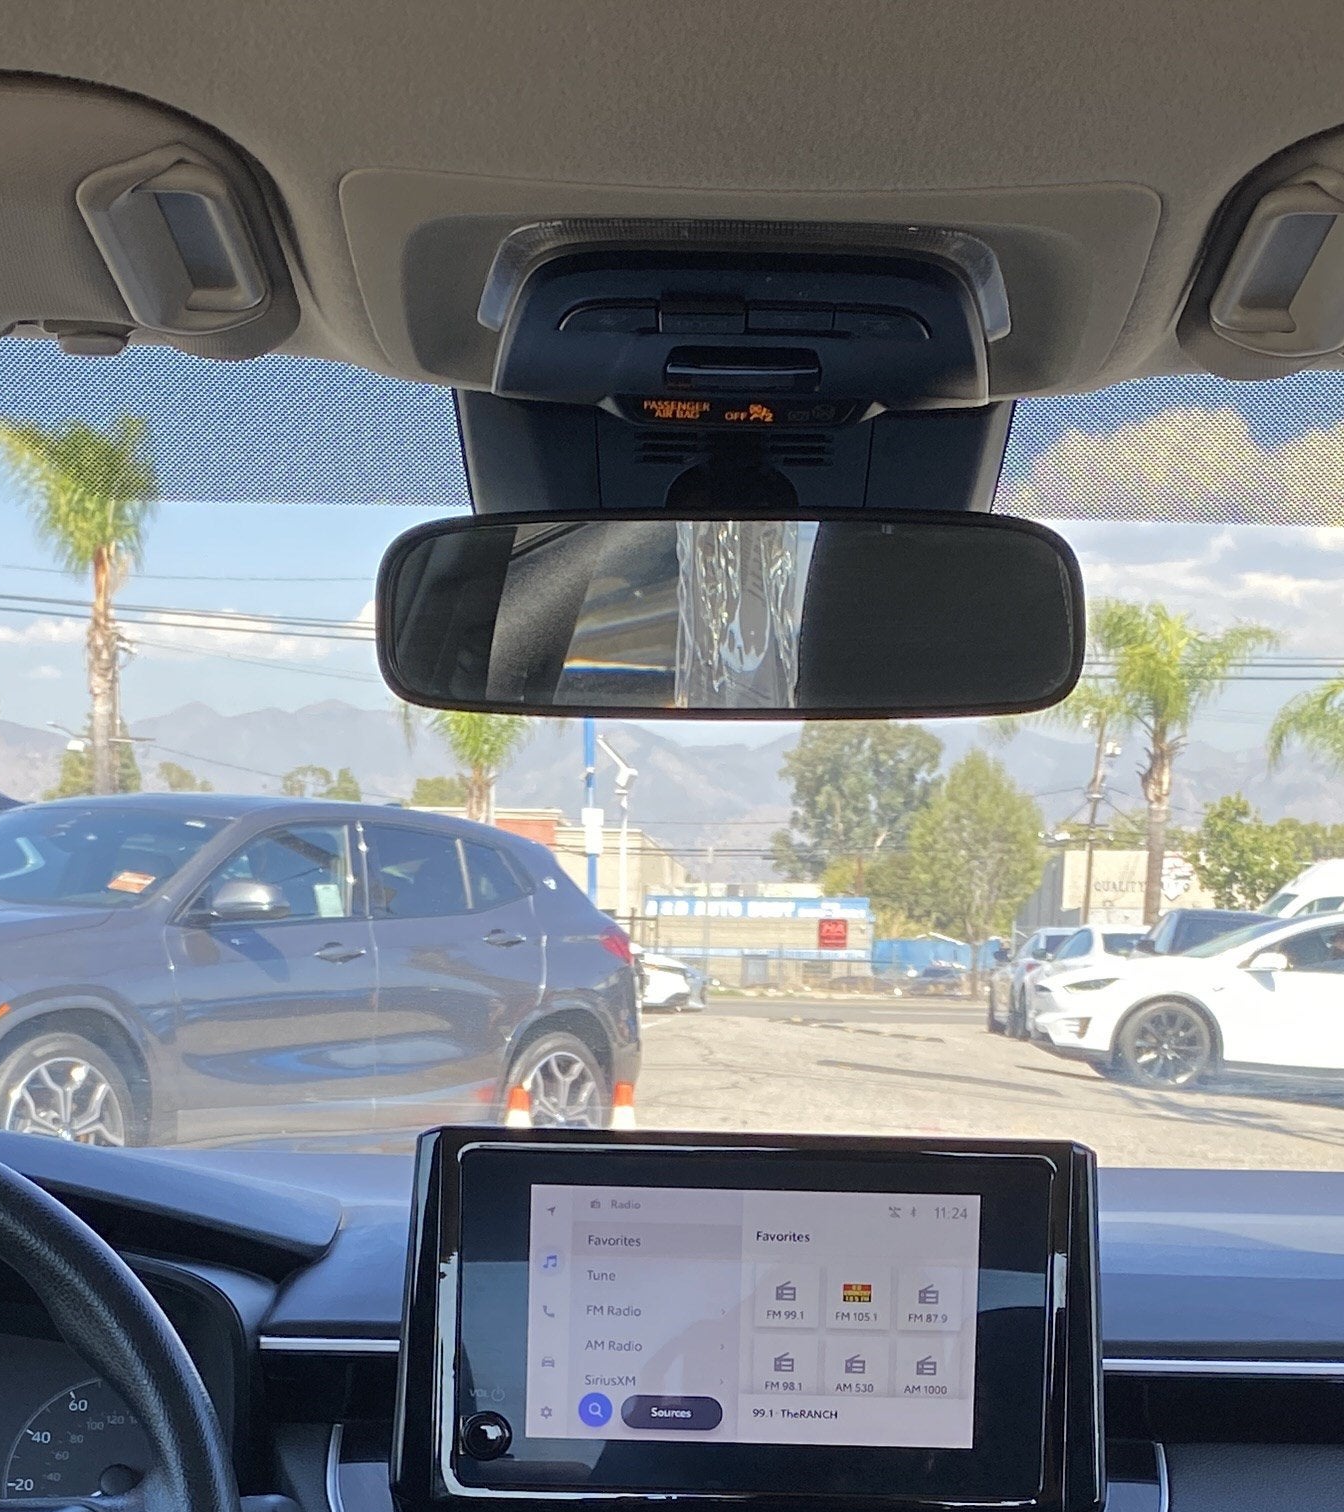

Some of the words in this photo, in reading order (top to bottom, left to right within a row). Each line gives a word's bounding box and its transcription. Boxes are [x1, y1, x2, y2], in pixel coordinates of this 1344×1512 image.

[643, 401, 710, 411] PASSENGER
[655, 409, 673, 418] AIR
[676, 410, 700, 419] BAG
[724, 411, 747, 420] OFF
[611, 1200, 641, 1210] Radio
[934, 1207, 968, 1220] 11:24
[588, 1235, 641, 1247] Favorites
[756, 1231, 810, 1243] Favorites
[587, 1270, 616, 1281] Tune
[586, 1306, 604, 1316] FM
[607, 1306, 641, 1317] Radio
[766, 1310, 781, 1319] FM
[783, 1310, 804, 1320] 99.1
[835, 1312, 850, 1321] FM
[853, 1312, 878, 1322] 105.1
[908, 1314, 923, 1322] FM
[926, 1314, 948, 1323] 87.9
[585, 1341, 605, 1351] AM
[608, 1340, 642, 1352] Radio
[585, 1375, 636, 1387] SiriusXM
[765, 1381, 779, 1390] FM
[782, 1381, 803, 1391] 98.1
[835, 1383, 852, 1392] AM
[855, 1384, 874, 1393] 530
[904, 1385, 921, 1394] AM
[924, 1385, 947, 1395] 1000
[69, 1399, 88, 1411] 60
[650, 1407, 692, 1419] Sources
[752, 1408, 773, 1418] 99.1
[781, 1408, 838, 1419] TheRANCH
[31, 1431, 51, 1444] 40
[14, 1479, 34, 1491] 20
